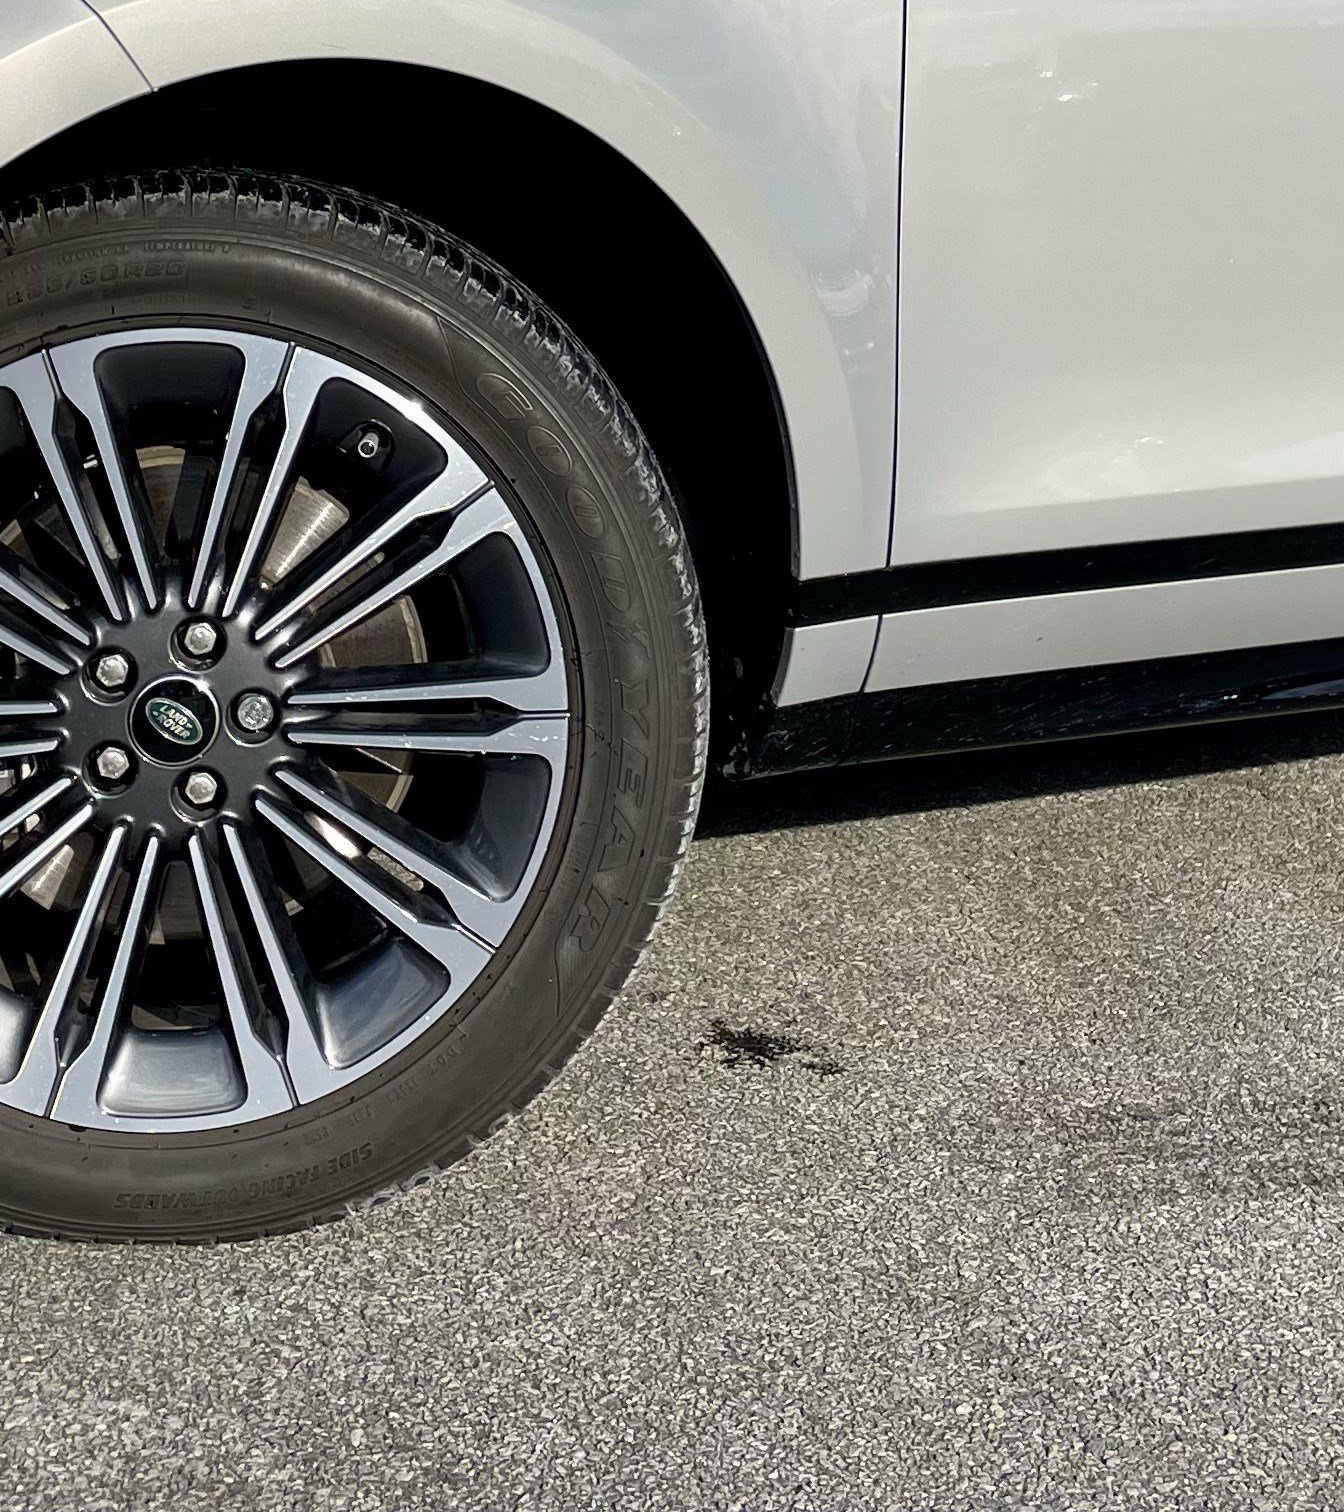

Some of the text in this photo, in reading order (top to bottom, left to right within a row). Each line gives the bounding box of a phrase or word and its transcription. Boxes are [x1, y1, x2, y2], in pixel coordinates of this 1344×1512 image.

[474, 372, 649, 953] GOODYEAR
[157, 713, 190, 739] ROVER
[160, 705, 188, 726] LAND
